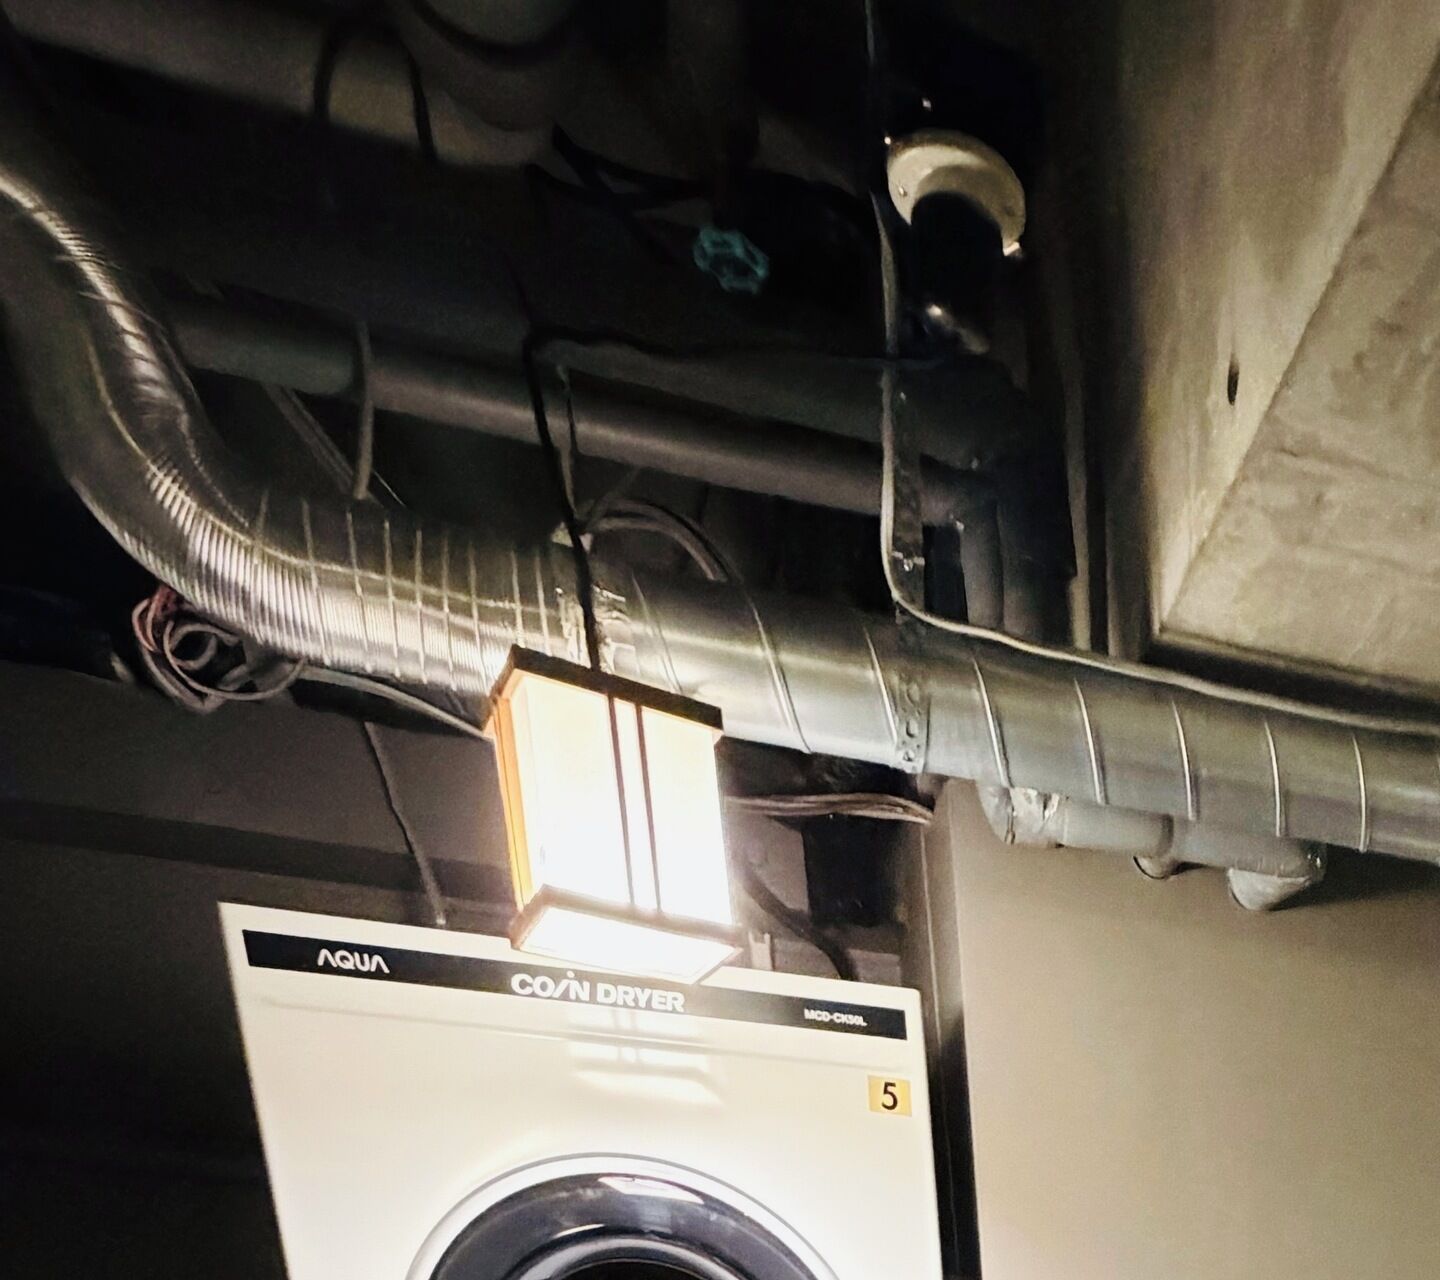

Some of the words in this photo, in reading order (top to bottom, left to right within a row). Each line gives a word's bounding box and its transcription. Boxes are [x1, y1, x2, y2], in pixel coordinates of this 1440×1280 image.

[317, 949, 390, 974] AQUA
[511, 971, 590, 1003] COIN
[597, 983, 685, 1012] DRYER
[881, 1081, 899, 1111] 5
